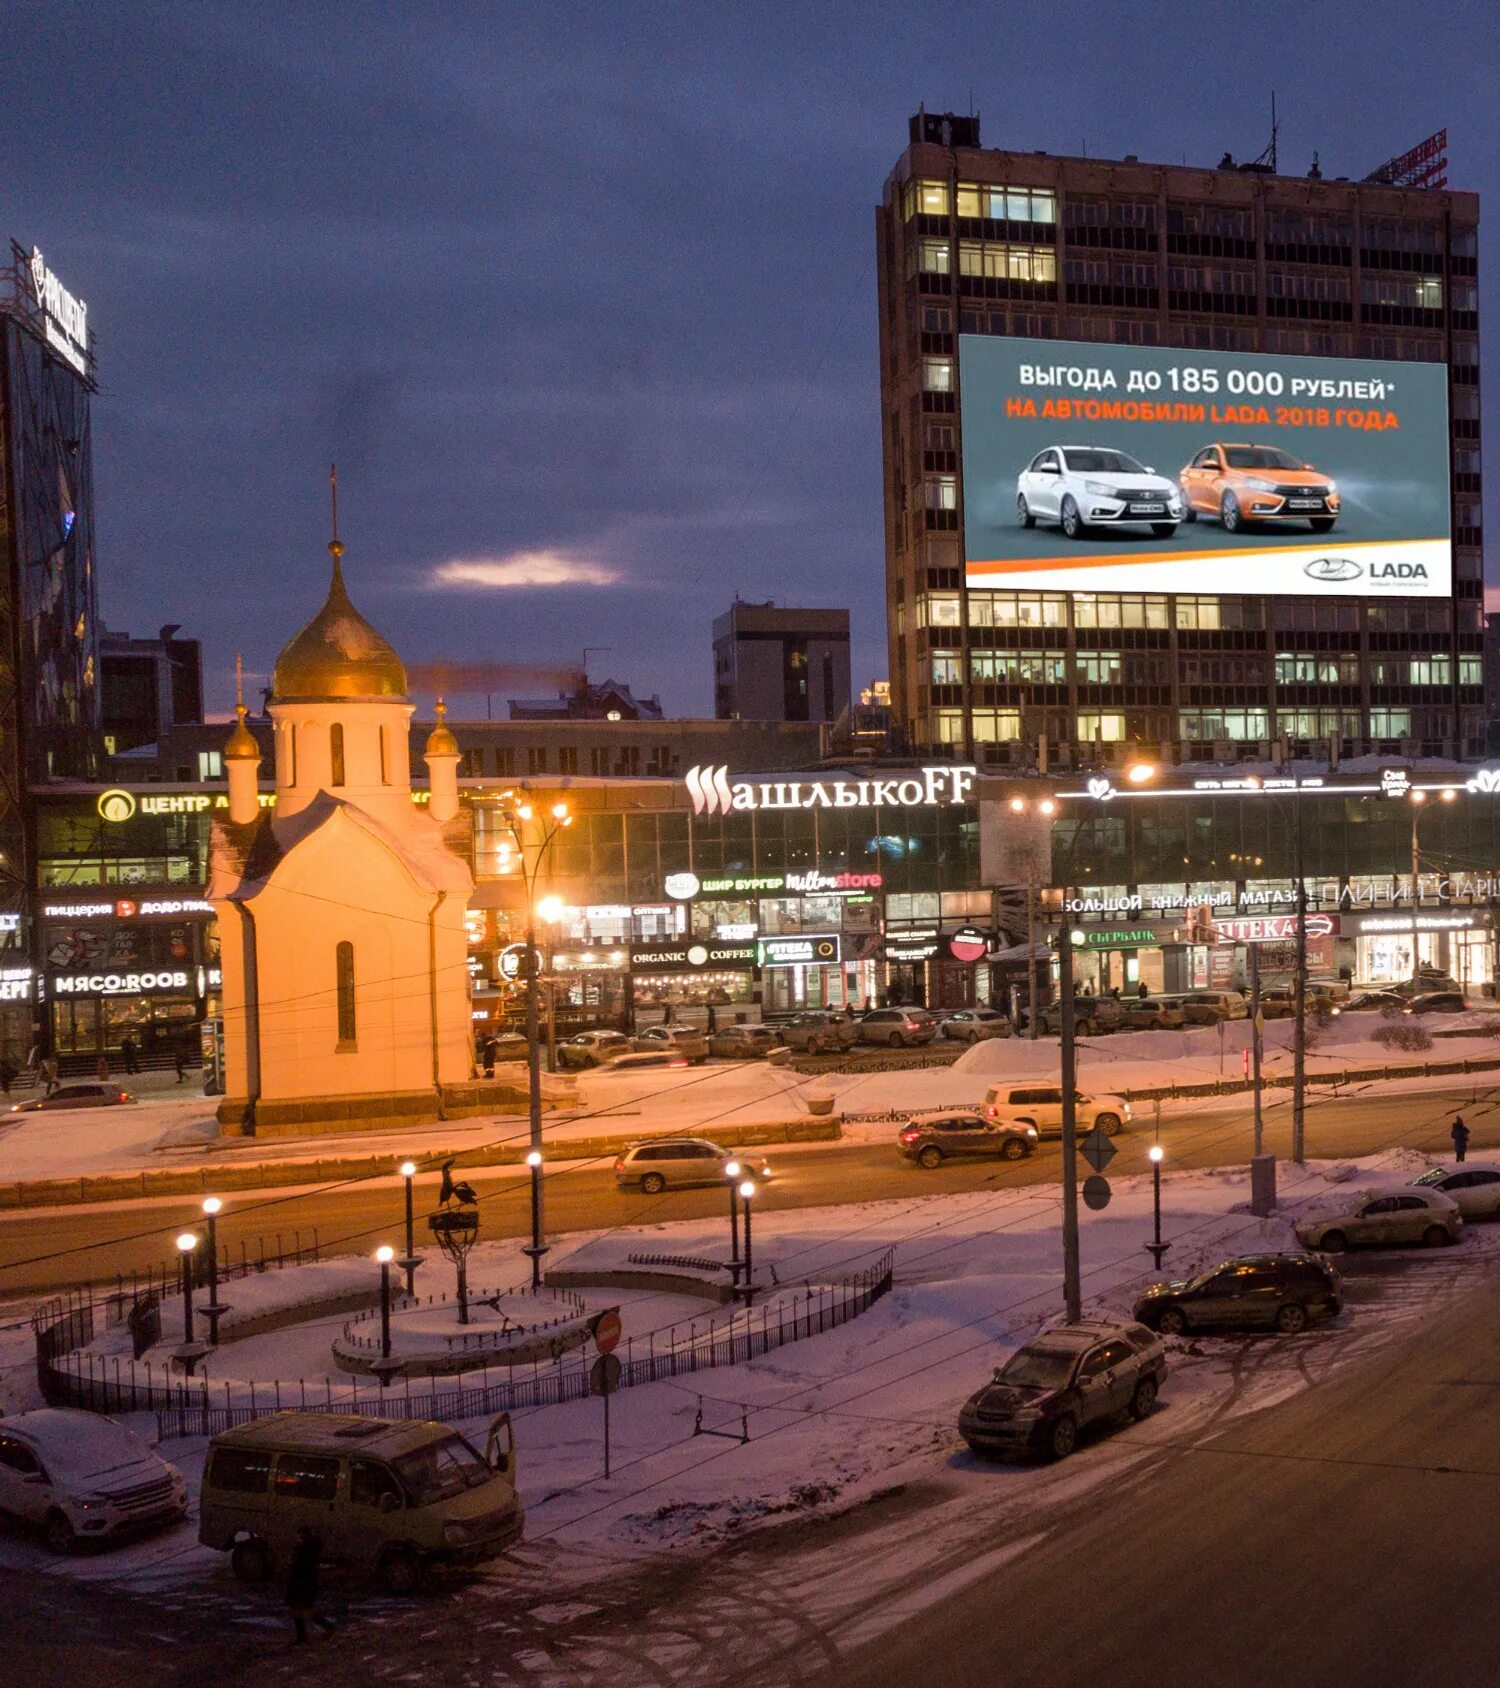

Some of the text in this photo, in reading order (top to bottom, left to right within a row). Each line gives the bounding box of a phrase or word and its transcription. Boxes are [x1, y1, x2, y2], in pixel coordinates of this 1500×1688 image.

[1020, 365, 1117, 391] ВЫГОДА
[1127, 371, 1161, 392] ДО
[1167, 367, 1220, 393] 185
[1227, 370, 1284, 396] 000
[1006, 398, 1399, 432] НА АВТОМОБИЛИ LADA 2018 ГОДА
[1370, 563, 1428, 578] LADA
[141, 796, 211, 815] ЦЕНТР
[702, 880, 734, 892] ШИР
[735, 878, 784, 891] БУРГЕР
[1061, 894, 1142, 912] БОЛЬШОЙ
[1152, 891, 1232, 910] КНИЖНЫЙ
[1088, 929, 1156, 944] СБЕРБАНК
[633, 950, 754, 963] ORGANIC COFFEE
[0, 981, 31, 1000] ЕРГ
